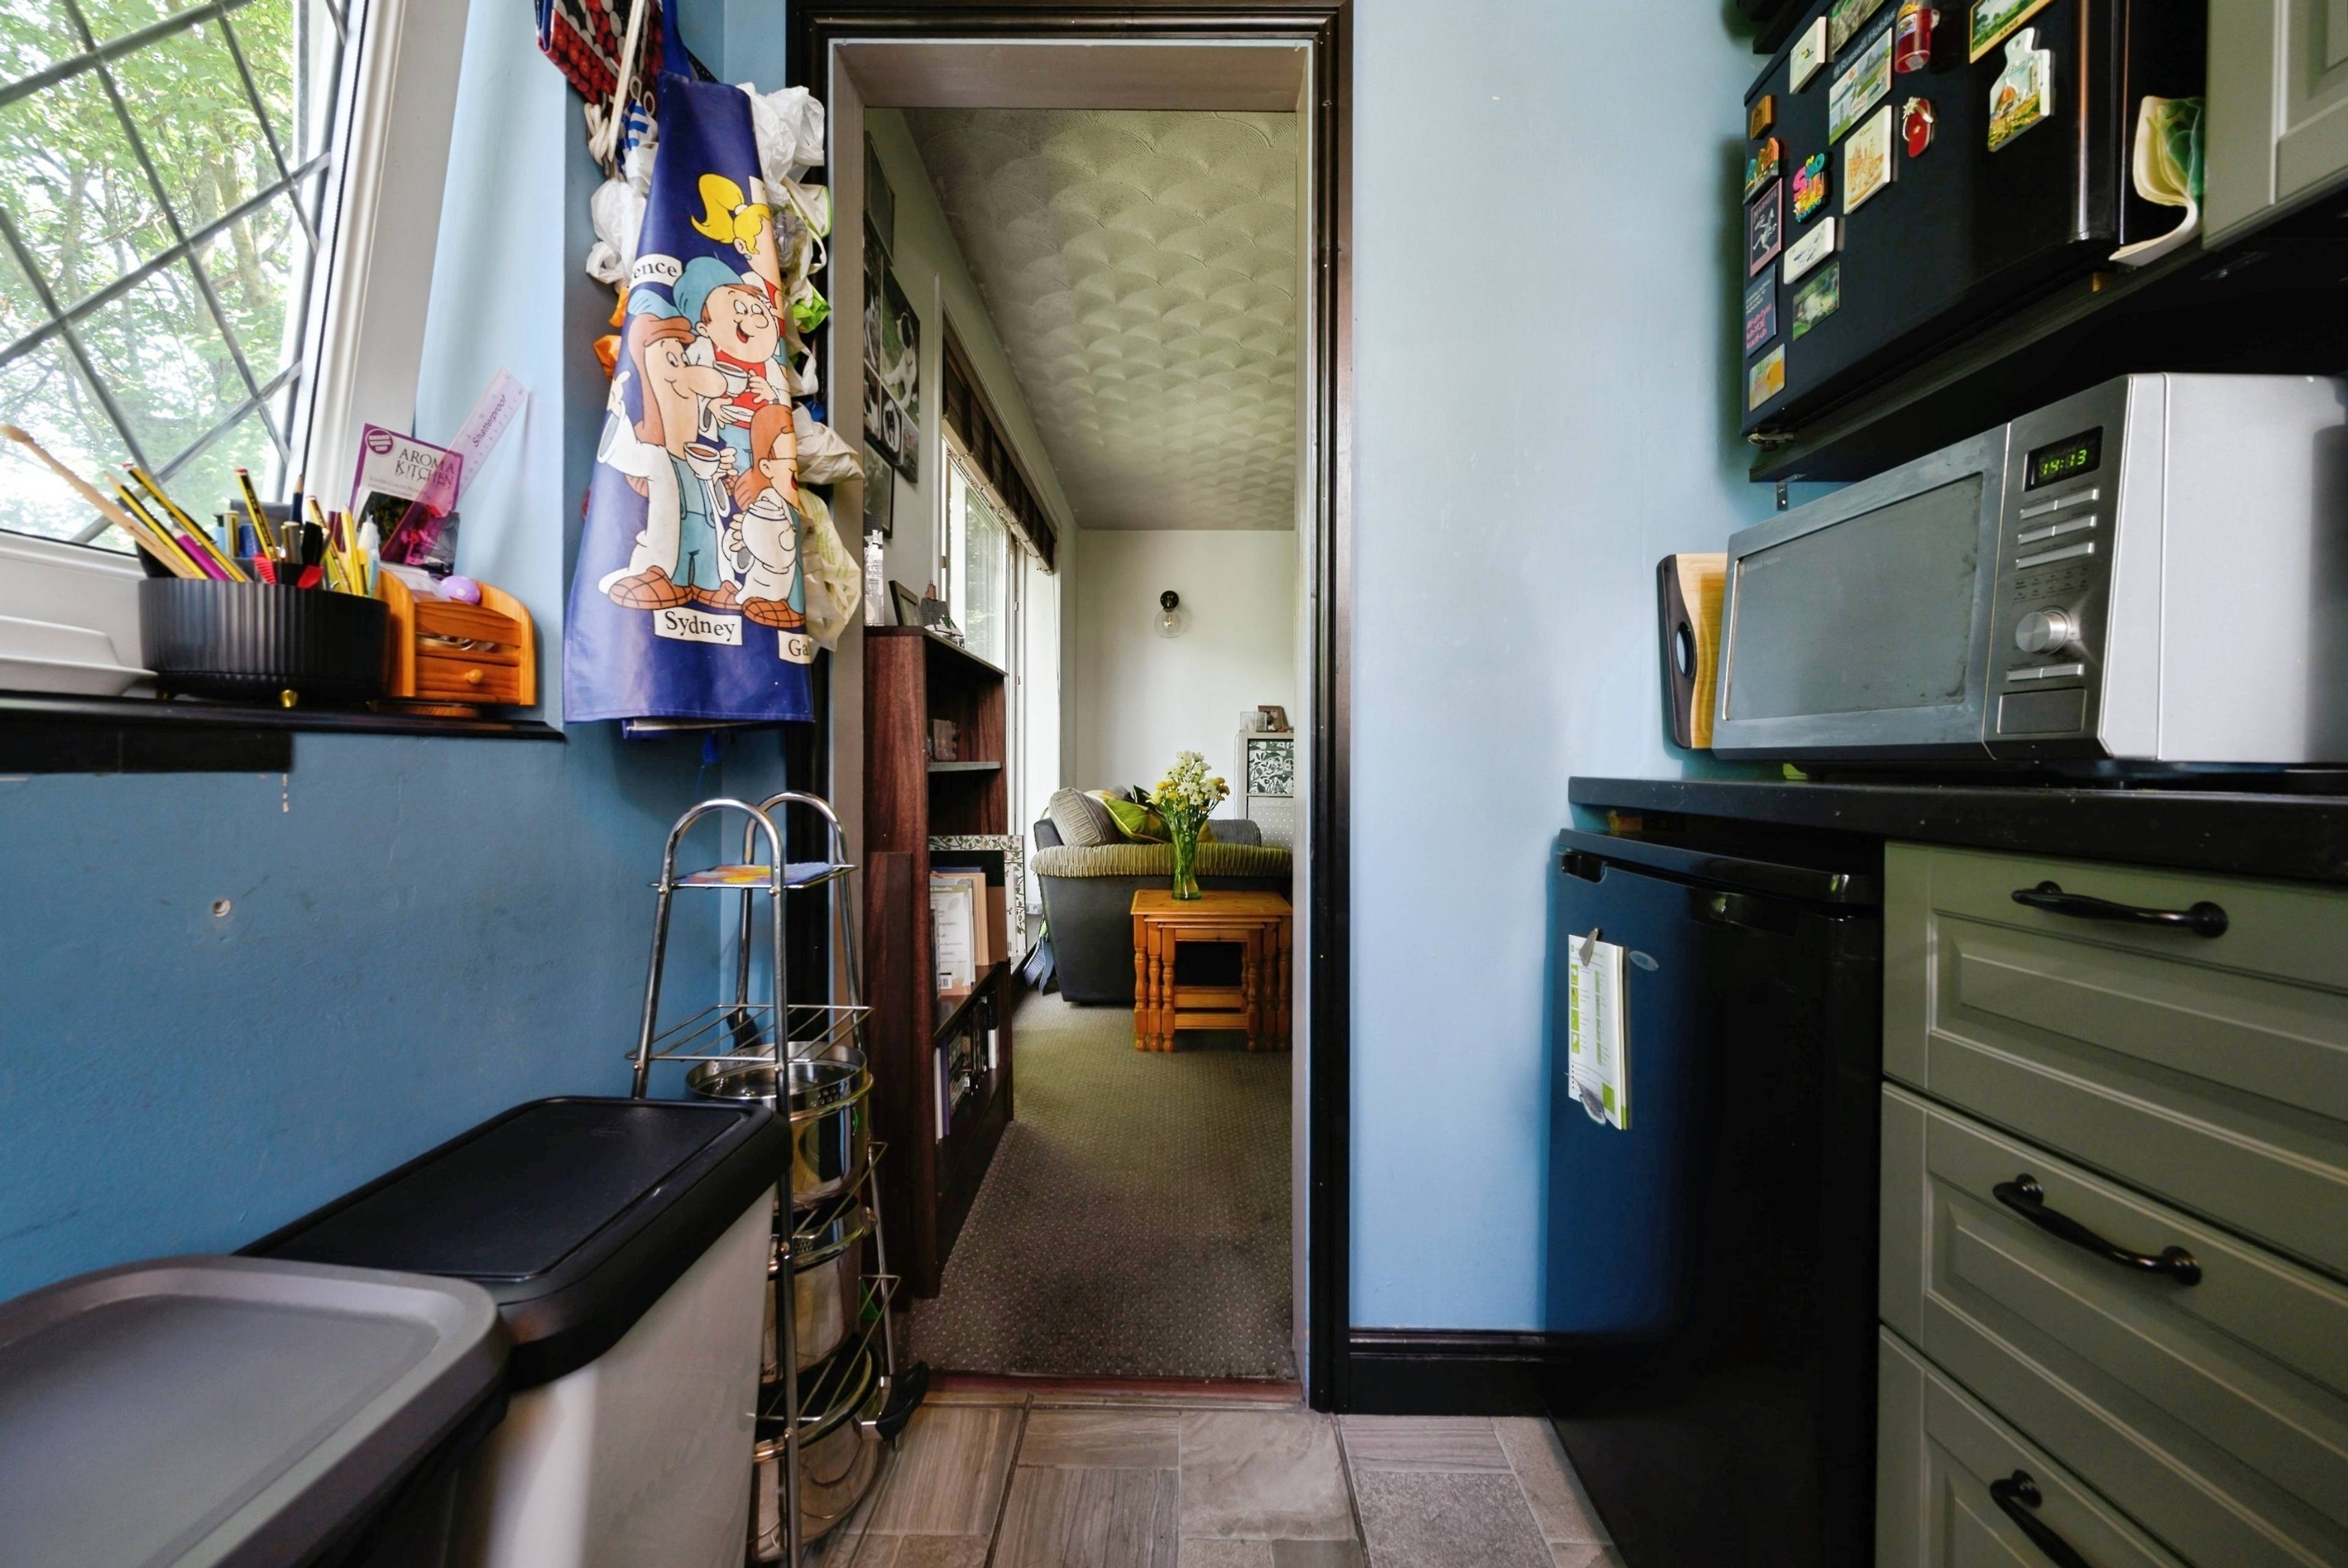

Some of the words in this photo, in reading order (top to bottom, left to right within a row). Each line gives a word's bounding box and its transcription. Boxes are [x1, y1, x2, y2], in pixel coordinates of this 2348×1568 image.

[473, 394, 506, 447] Shatterproof
[395, 460, 454, 487] KITCHEN
[399, 448, 454, 474] AROMA
[2042, 449, 2086, 474] 14:13
[665, 611, 735, 642] Sydney
